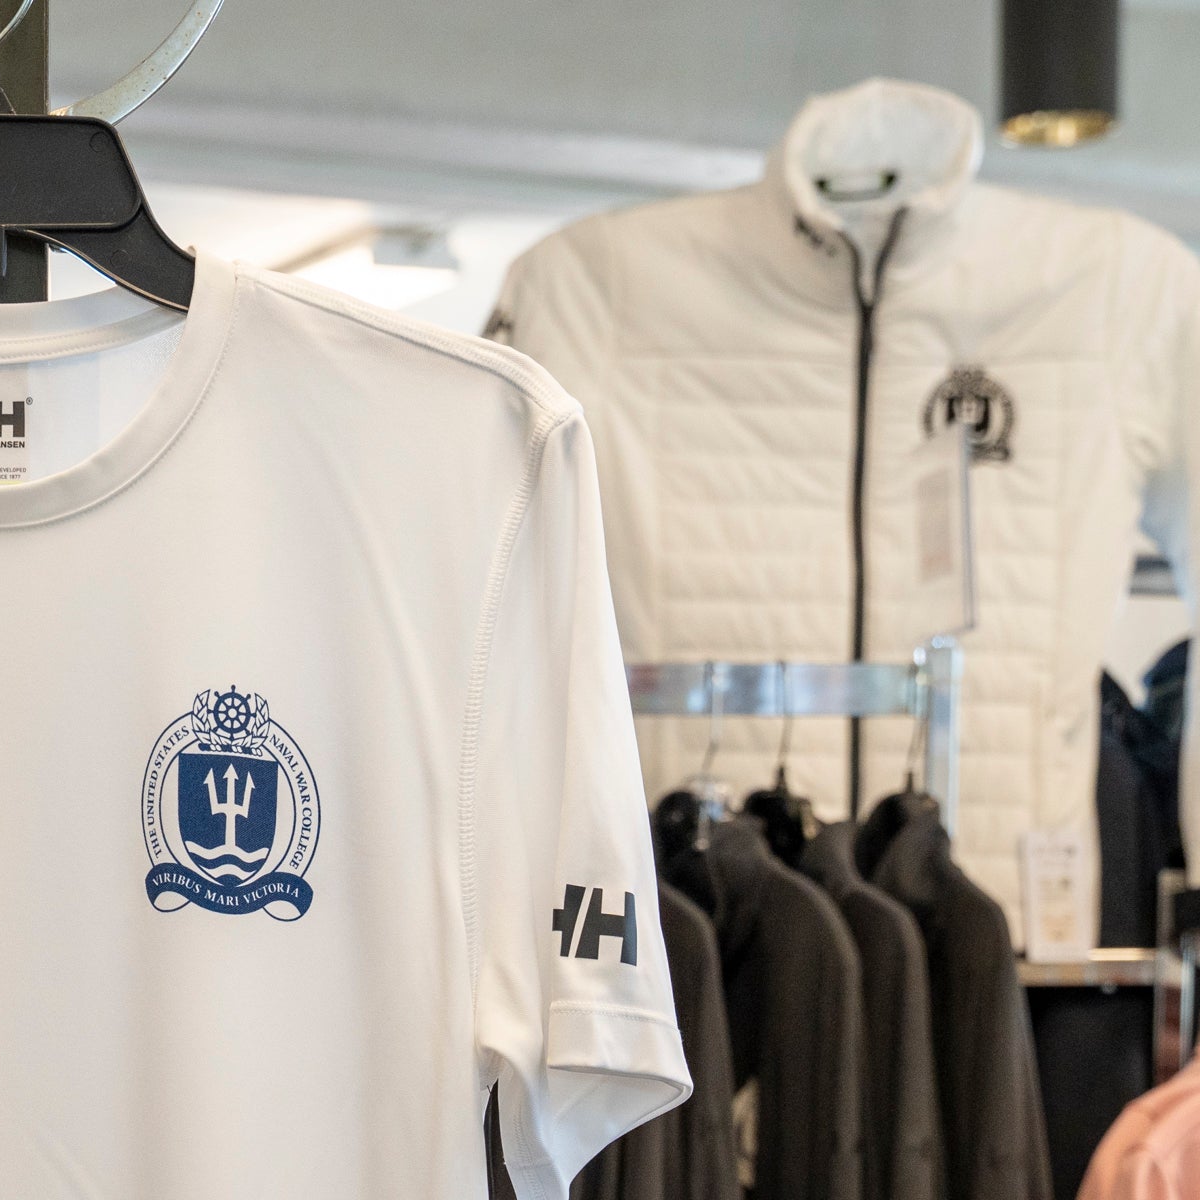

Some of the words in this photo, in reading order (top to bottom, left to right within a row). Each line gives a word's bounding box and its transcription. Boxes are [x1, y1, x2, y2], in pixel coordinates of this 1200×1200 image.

[154, 725, 190, 769] STATES
[269, 734, 299, 772] NAVAL
[147, 770, 159, 826] UNITED
[295, 771, 311, 804] WAR
[149, 828, 162, 858] THE
[289, 807, 312, 870] COLLEGE
[152, 873, 201, 893] VIRIBUS
[204, 889, 239, 906] MARI
[243, 882, 300, 904] VICTORIA
